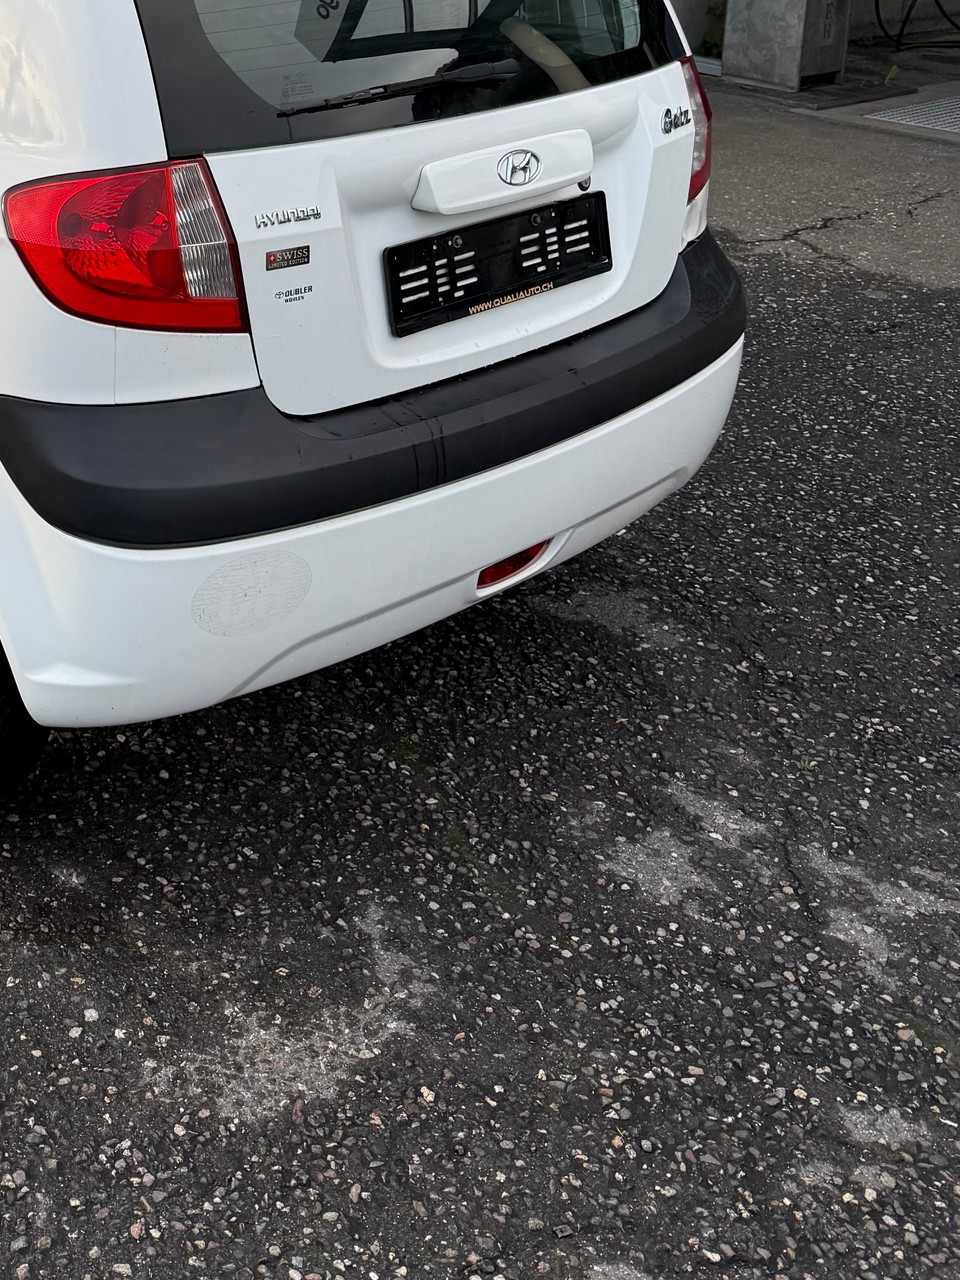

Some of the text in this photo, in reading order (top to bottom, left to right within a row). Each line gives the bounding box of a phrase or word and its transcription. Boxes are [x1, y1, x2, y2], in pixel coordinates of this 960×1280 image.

[255, 206, 321, 229] HYUNDAI
[276, 248, 309, 261] SWISS
[468, 281, 554, 315] WWW.QUALIAUTO.CH
